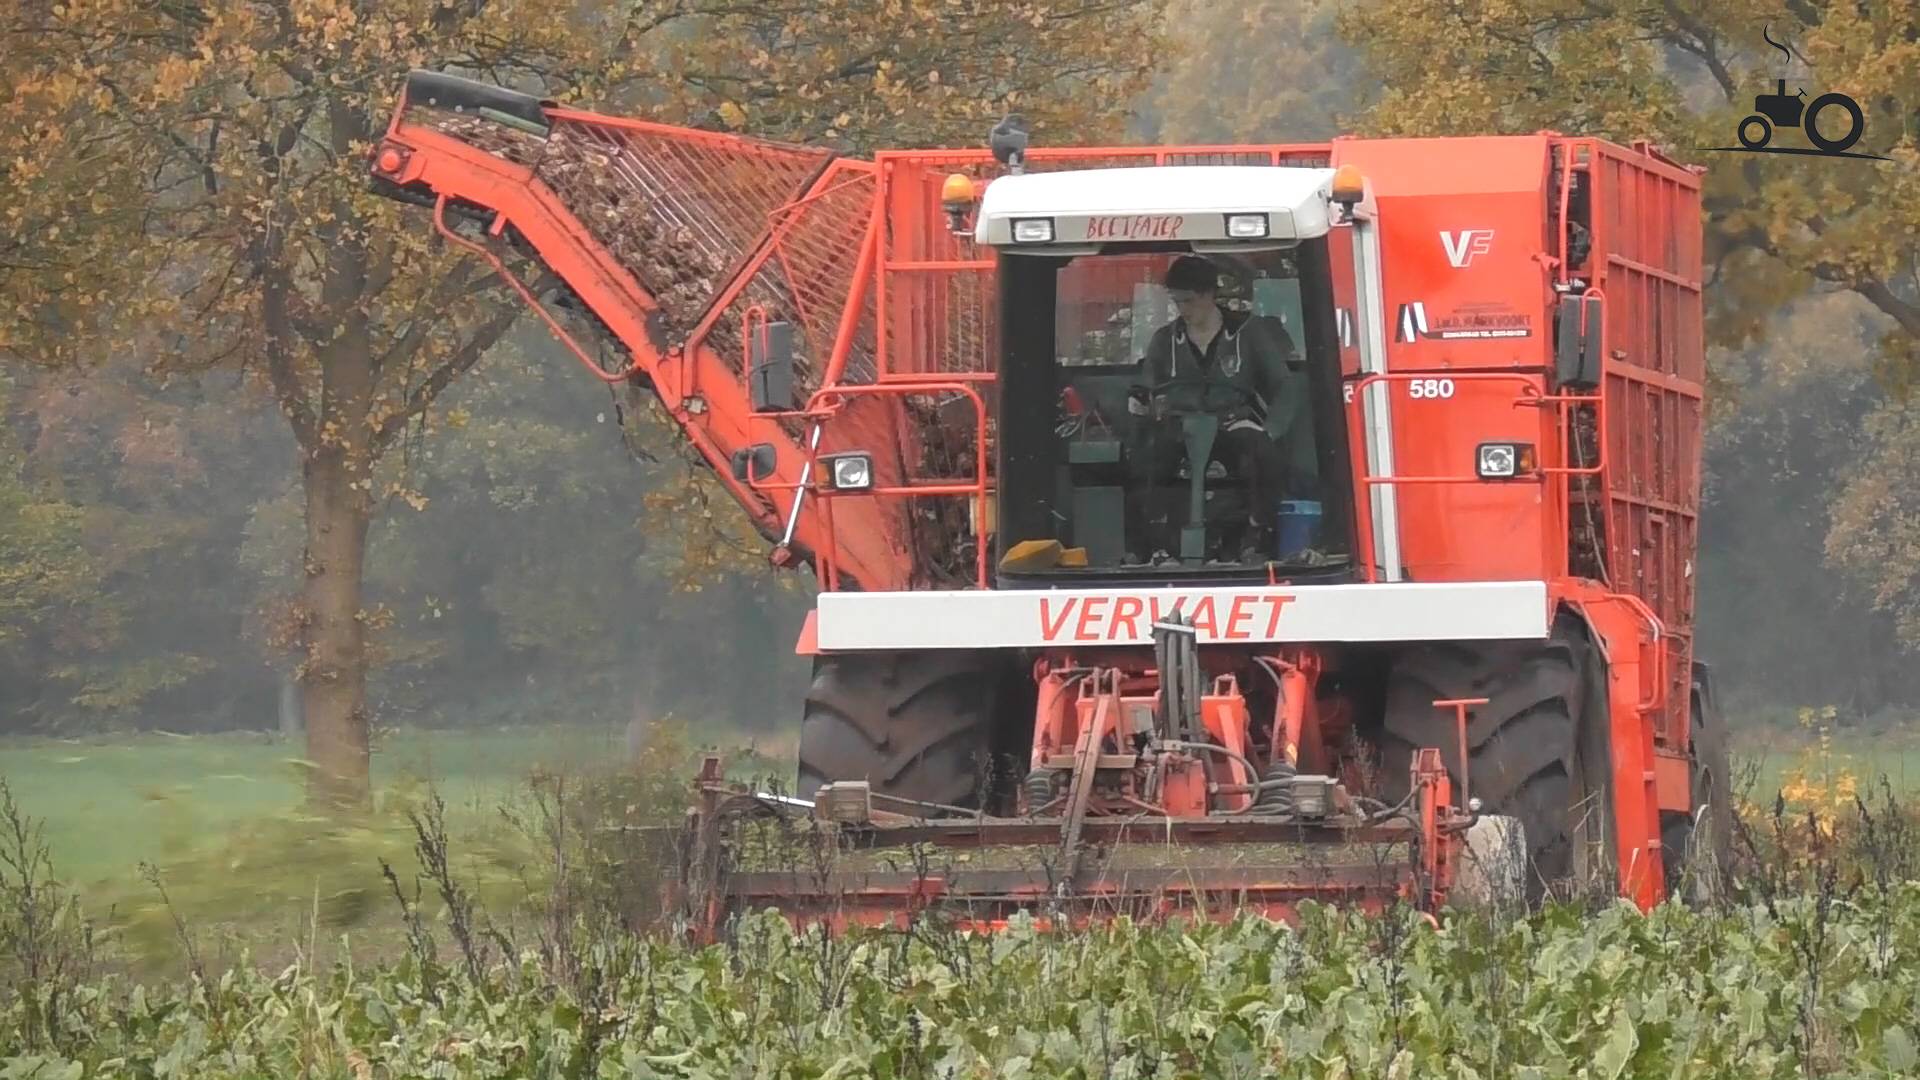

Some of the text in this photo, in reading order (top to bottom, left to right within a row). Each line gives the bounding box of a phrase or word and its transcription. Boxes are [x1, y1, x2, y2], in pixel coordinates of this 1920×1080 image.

[1087, 216, 1183, 239] BEETEATER
[1410, 379, 1455, 398] 580
[1040, 595, 1296, 641] VERVAET
